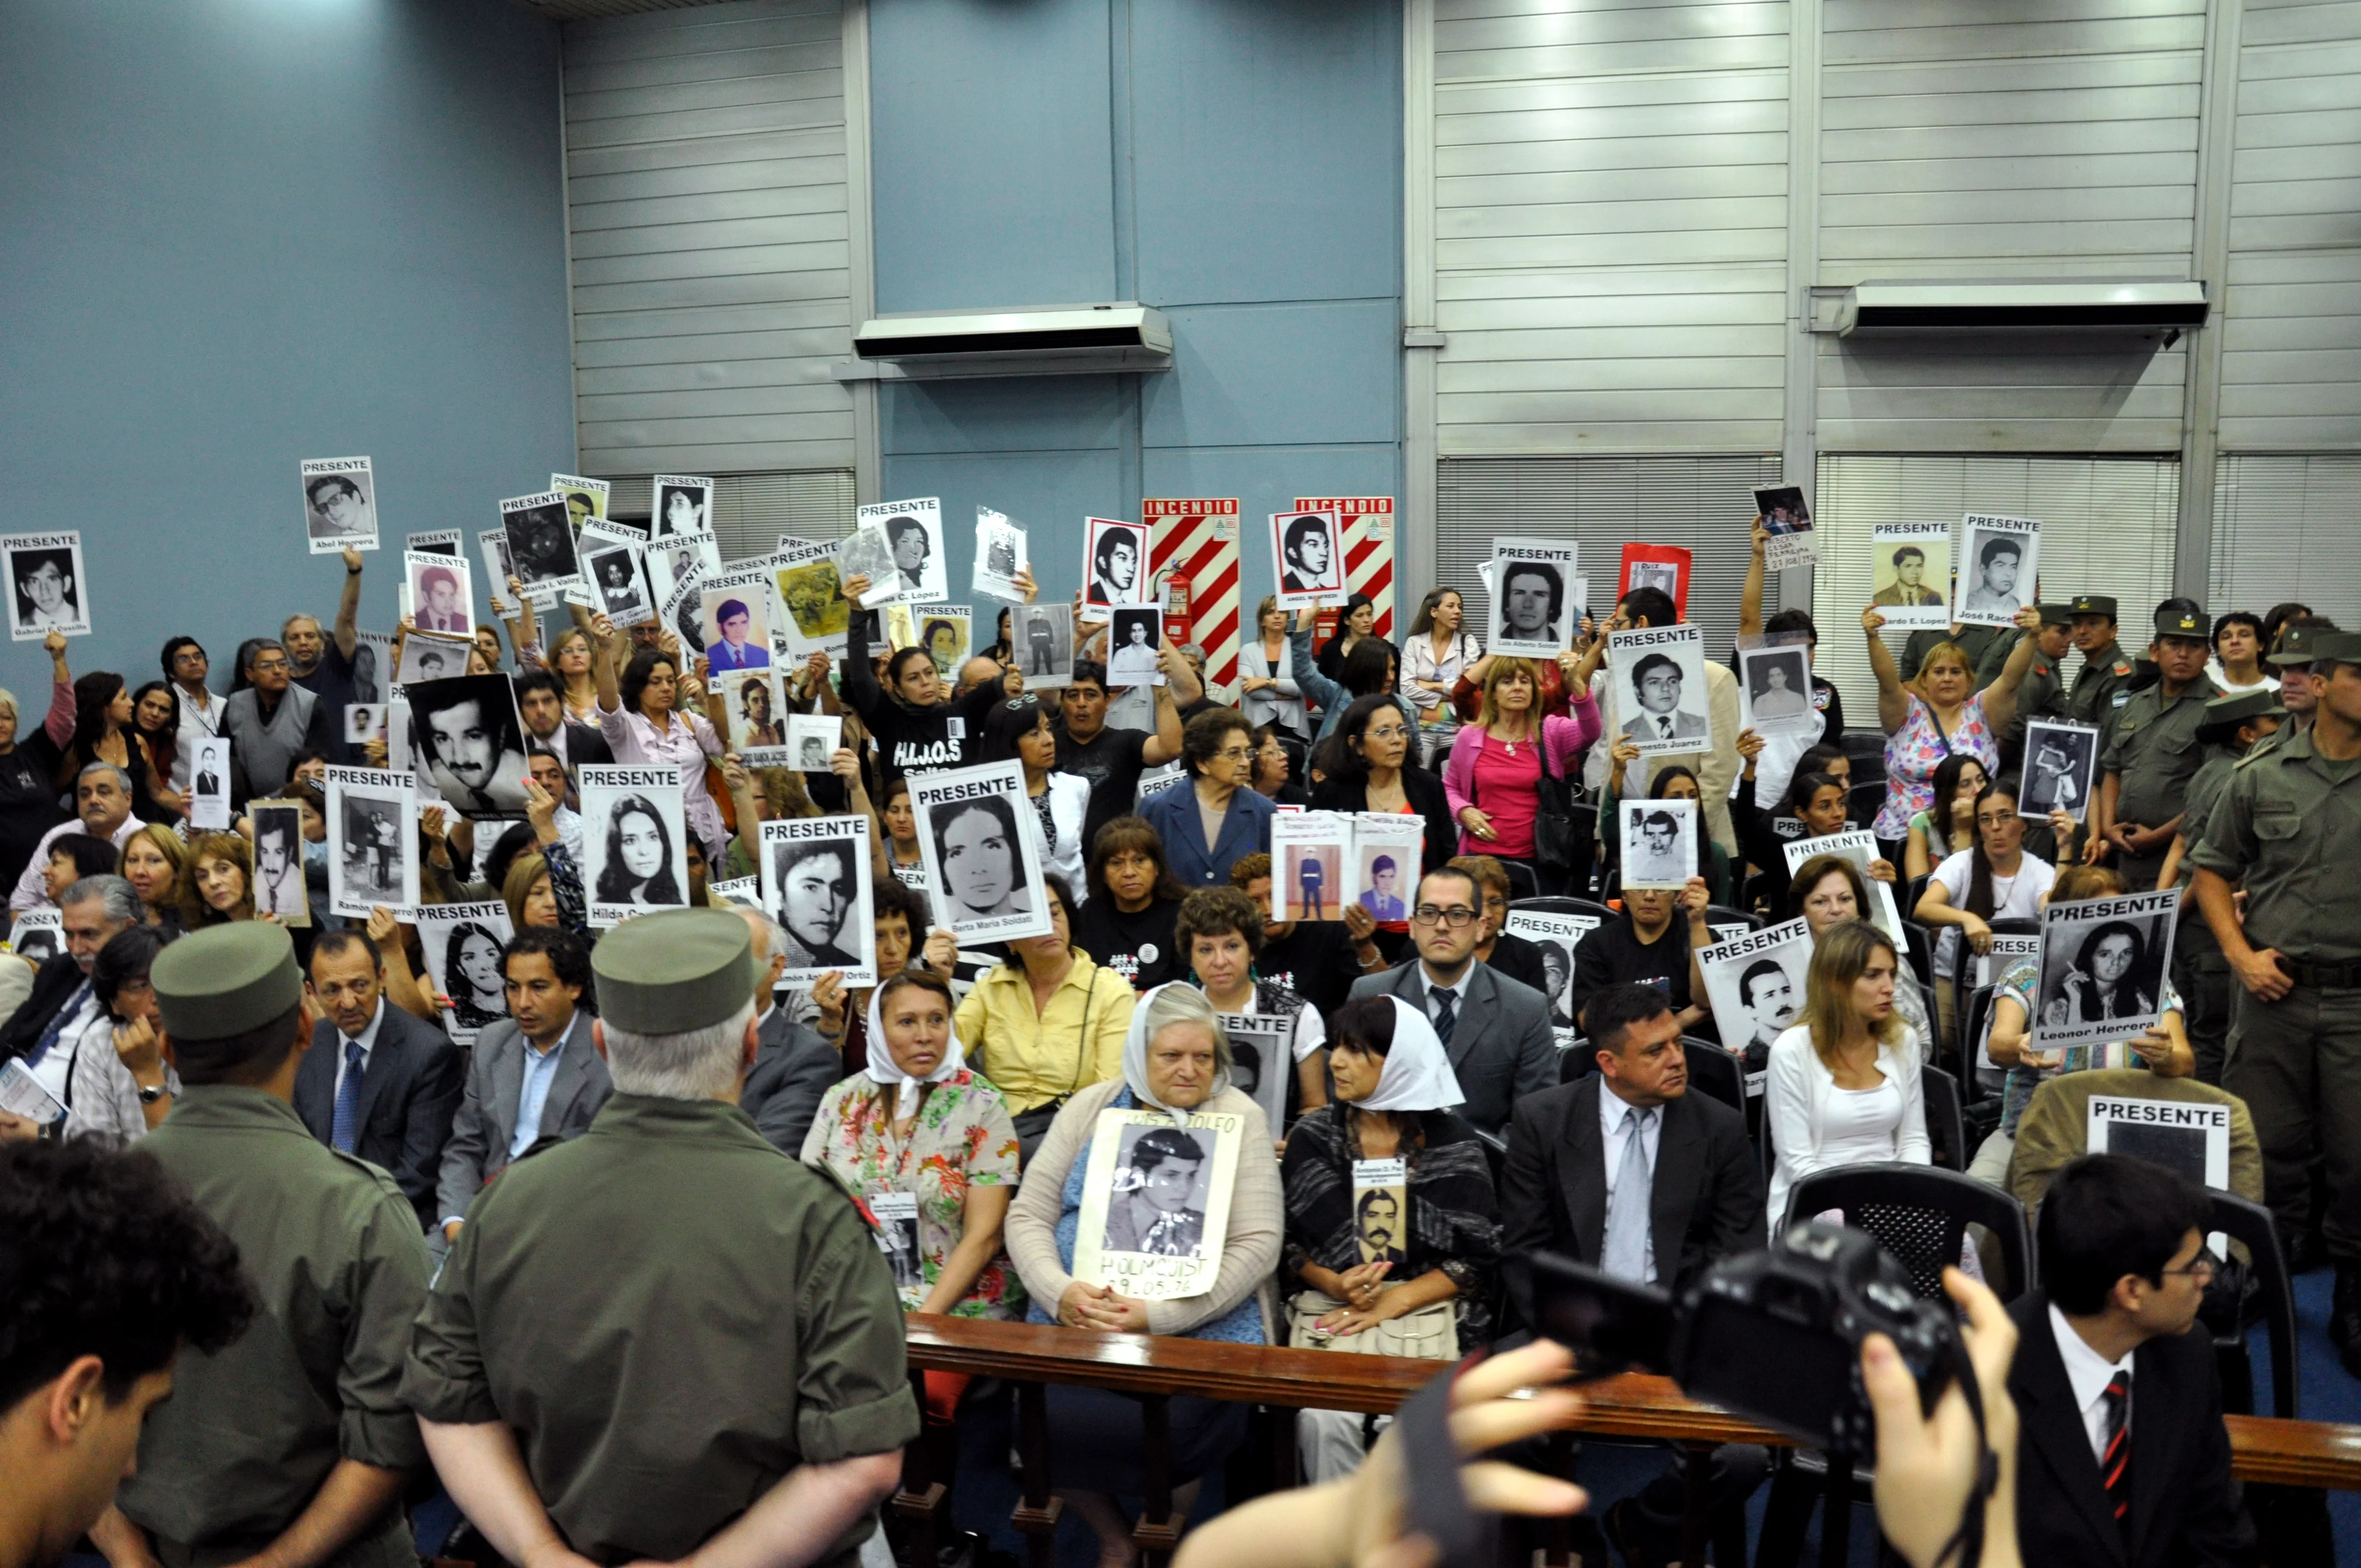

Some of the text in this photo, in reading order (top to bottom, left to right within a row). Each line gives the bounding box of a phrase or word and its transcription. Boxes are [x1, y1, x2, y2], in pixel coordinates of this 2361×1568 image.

[303, 460, 368, 472] PRESENTE
[554, 477, 607, 492] PRESENTE
[657, 476, 712, 487] PRESENTE
[503, 492, 564, 510] PRESENTE
[861, 500, 937, 516] PRESENTE
[1148, 500, 1233, 515] INCENDIO
[1301, 499, 1387, 513] INCENDIO
[586, 519, 645, 540] PRESENTE
[1875, 523, 1949, 533] PRESENTE
[1968, 516, 2041, 532] PRESENTE
[3, 535, 78, 548] PRESENTE
[315, 540, 336, 548] Abel
[409, 531, 460, 544] PRESENTE
[482, 531, 507, 543] PRES
[647, 532, 714, 553] PRESENTE
[407, 554, 466, 568] PRESENTE
[770, 542, 839, 567] PRESENTE
[1499, 548, 1571, 560] PRESENTE
[726, 559, 767, 573] PRESEN
[662, 558, 706, 617] PRESENTE
[702, 573, 763, 590] PRESENTE
[911, 590, 940, 600] López
[917, 607, 971, 616] PRESENTE
[1959, 610, 2014, 623] José Race
[15, 627, 46, 636] Gabriel
[1613, 629, 1698, 648] PRESENTE
[1669, 738, 1702, 748] Juarez
[893, 738, 962, 766] H.I.J.O.S
[329, 769, 415, 788] PRESENTE
[584, 770, 678, 786] PRESENTE
[918, 776, 1018, 805] PRESENTE
[764, 819, 866, 841] PRESENTE
[1789, 833, 1874, 857] PRESENTE
[712, 876, 758, 893] SENTE
[338, 901, 370, 913] Ramón
[417, 902, 505, 920] PRESENTE
[592, 907, 623, 918] Hilda
[2048, 894, 2175, 923] PRESENTE
[952, 922, 974, 933] Berta
[1002, 914, 1033, 927] Soldati
[1511, 916, 1583, 938] PRESENT
[1703, 921, 1807, 964] PRESENTE
[1992, 940, 2038, 954] RESE
[846, 971, 871, 979] Ortiz
[1218, 1015, 1288, 1035] ENTE
[2039, 1021, 2155, 1042] Leonor Herrera
[2093, 1102, 2226, 1128] PRESENTE
